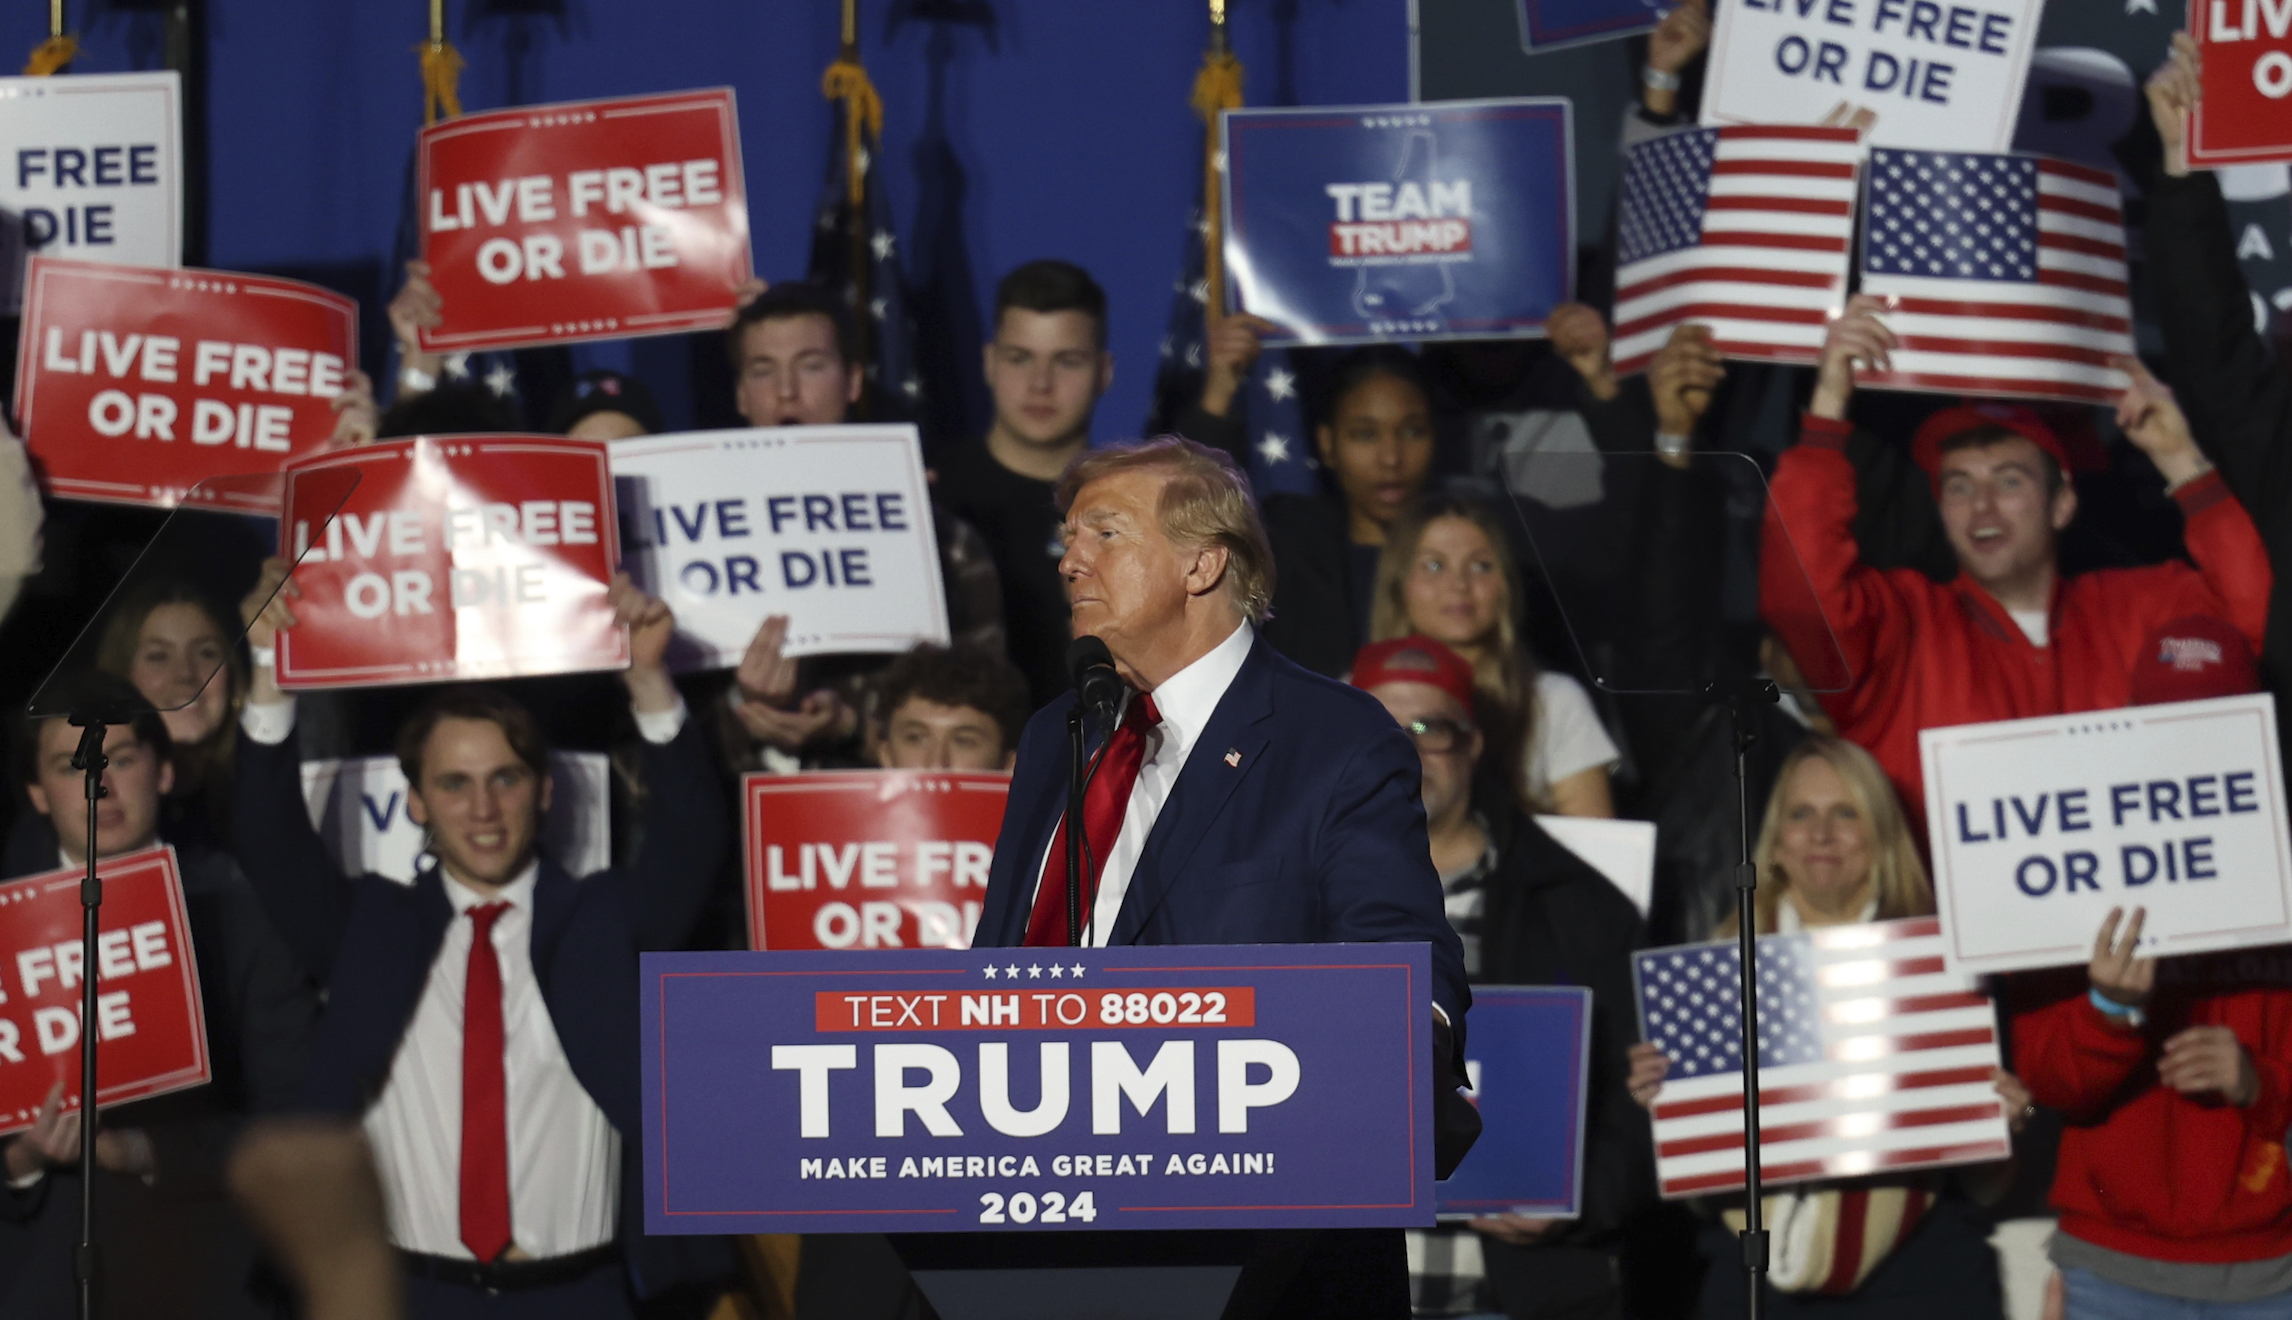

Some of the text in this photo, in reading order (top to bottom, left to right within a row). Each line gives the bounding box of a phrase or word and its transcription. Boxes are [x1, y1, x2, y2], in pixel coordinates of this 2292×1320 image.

[1873, 0, 2013, 56] FREE
[1775, 34, 1955, 105] OR DIE
[18, 145, 158, 188] FREE
[429, 158, 722, 233] LIVE FREE
[1325, 180, 1472, 222] TEAM
[23, 204, 114, 247] DIE
[1333, 221, 1467, 254] TRUMP
[475, 223, 680, 285] OR DIE
[44, 326, 345, 398] LIVE FREE
[88, 389, 294, 452] OR DIE
[294, 500, 598, 564] LIVE FREE
[767, 493, 908, 534] FREE
[344, 563, 547, 619] OR DIE
[680, 548, 874, 597] OR DIE
[1956, 770, 2260, 843] LIVE FREE
[766, 841, 899, 891] LIVE
[2015, 836, 2218, 897] OR DIE
[813, 901, 904, 949] OR
[15, 919, 173, 999] FREE
[844, 992, 1227, 1028] TEXT NH TO 88022
[771, 1039, 1301, 1138] TRUMP
[800, 1152, 1275, 1180] MAKE AMERICA GREAT AGAIN!
[979, 1191, 1097, 1224] 2024
